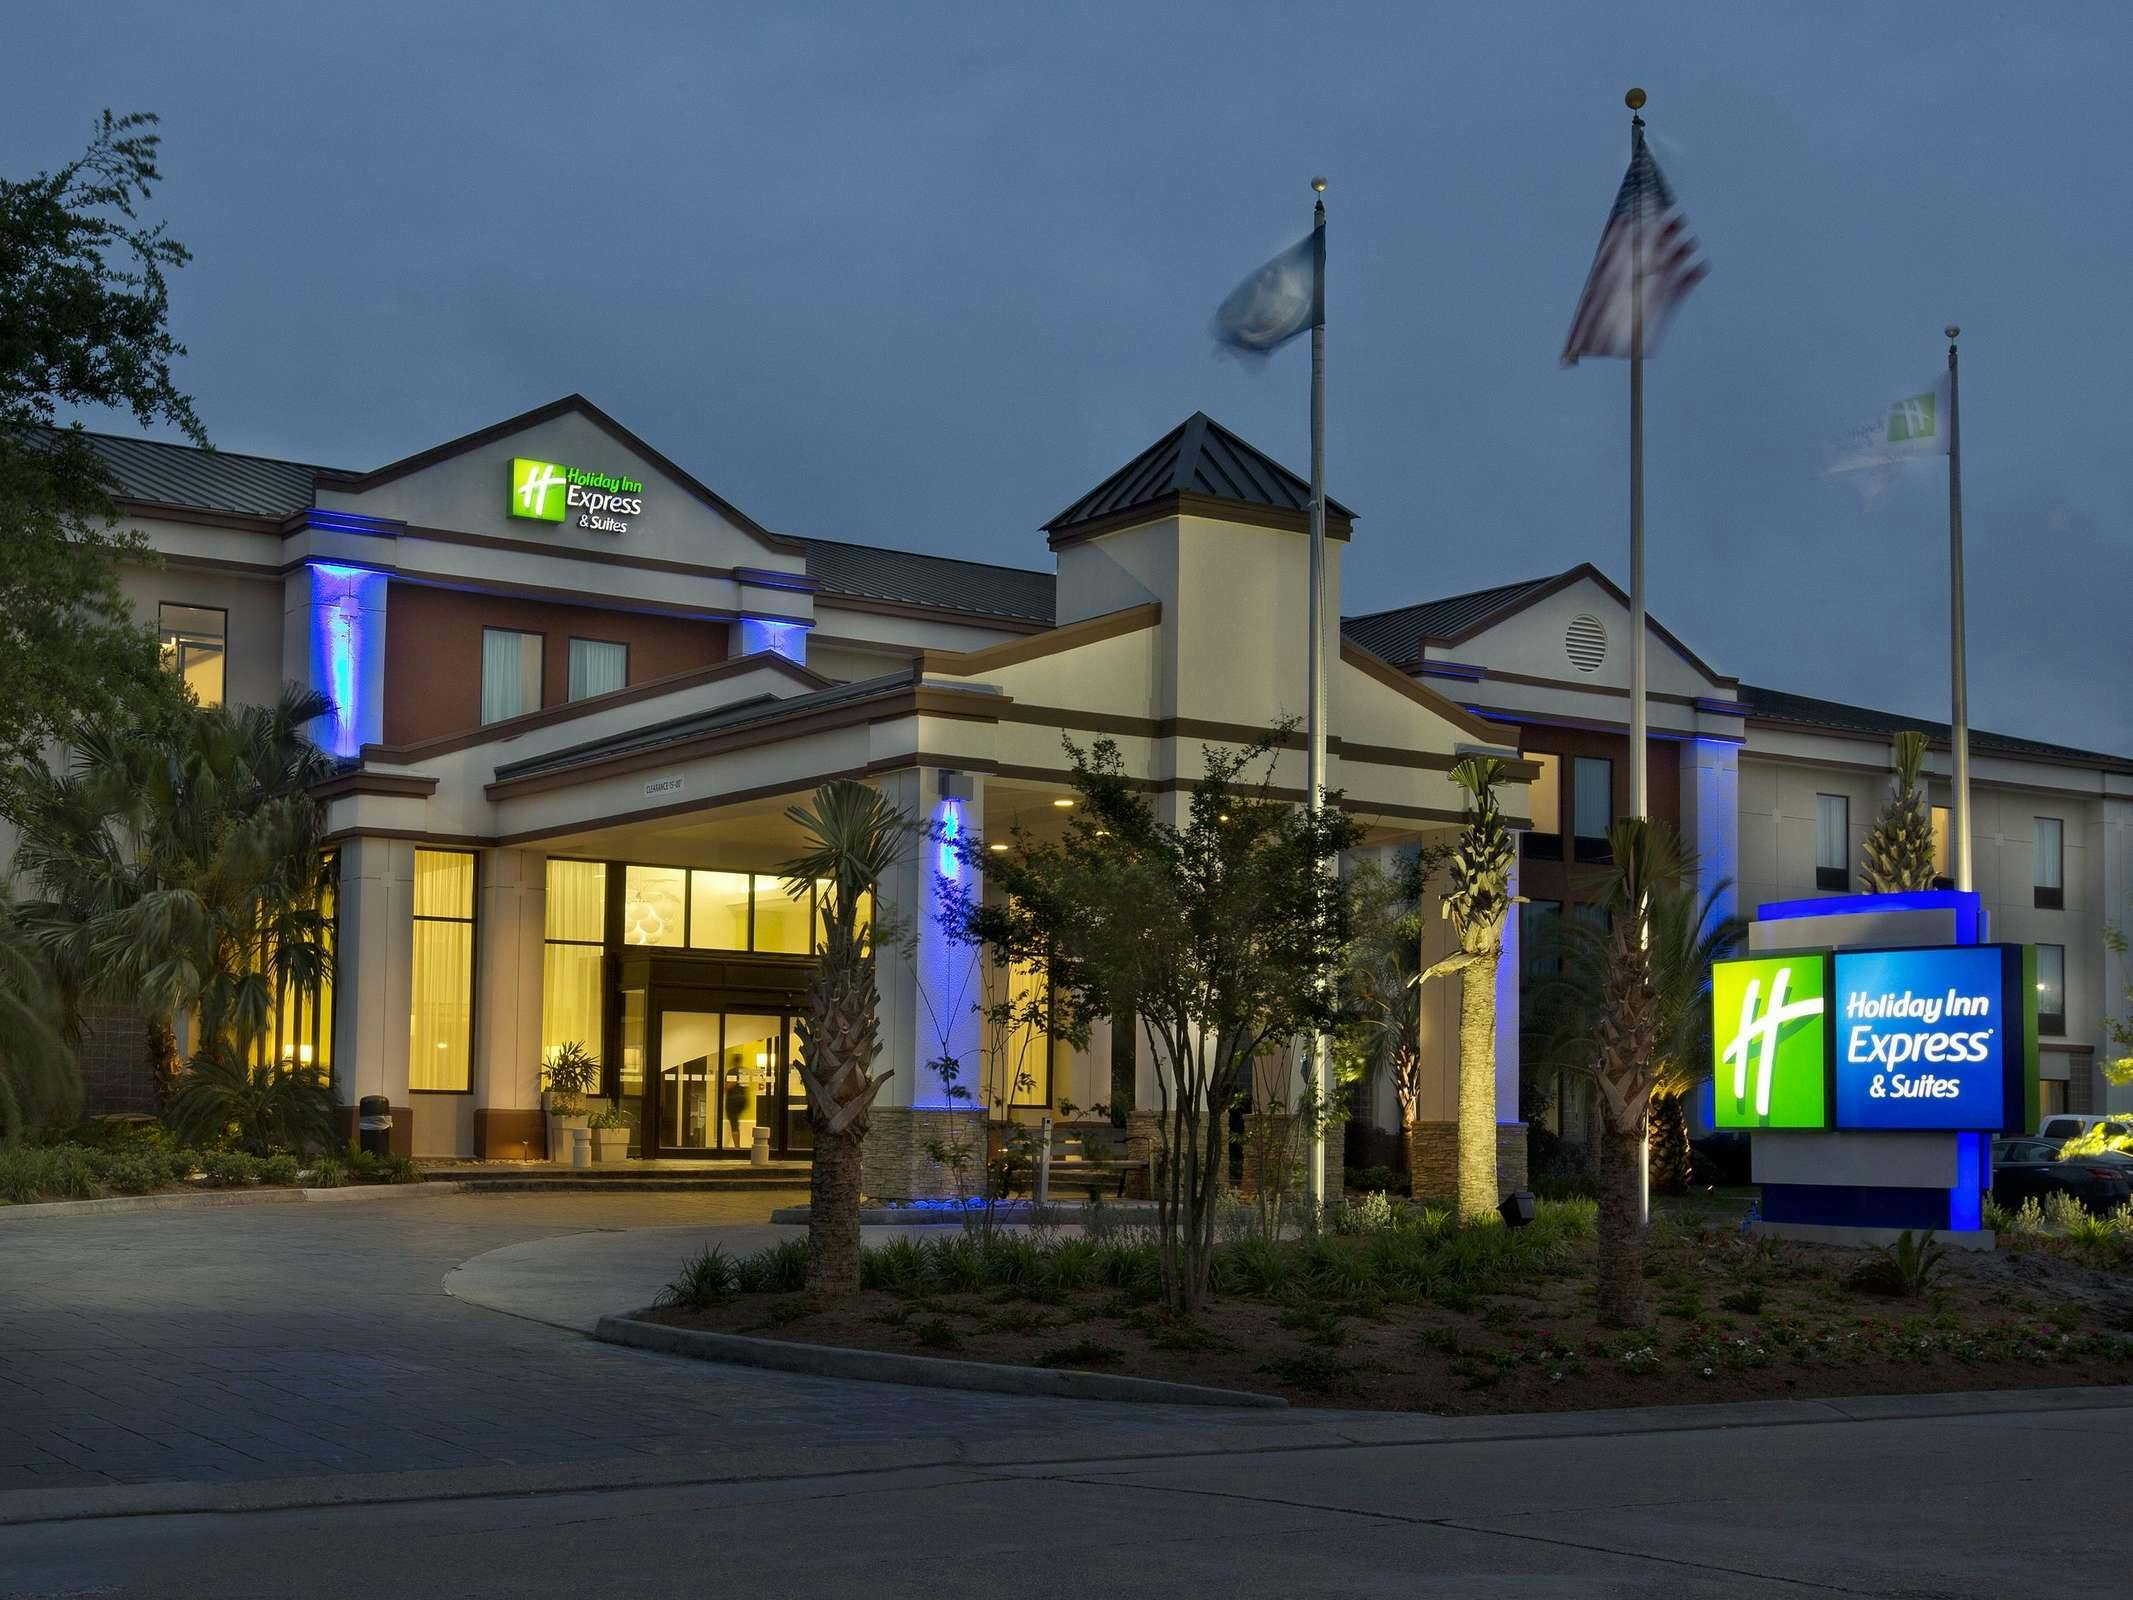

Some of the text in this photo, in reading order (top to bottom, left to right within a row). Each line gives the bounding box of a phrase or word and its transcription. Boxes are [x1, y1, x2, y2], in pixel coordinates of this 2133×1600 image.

[567, 467, 642, 493] Holiday Inn
[566, 484, 642, 515] Express
[579, 514, 628, 533] & Suites
[1845, 988, 1990, 1023] Holiday Inn
[1847, 1025, 1990, 1072] Express
[1869, 1074, 1960, 1098] & Suites
